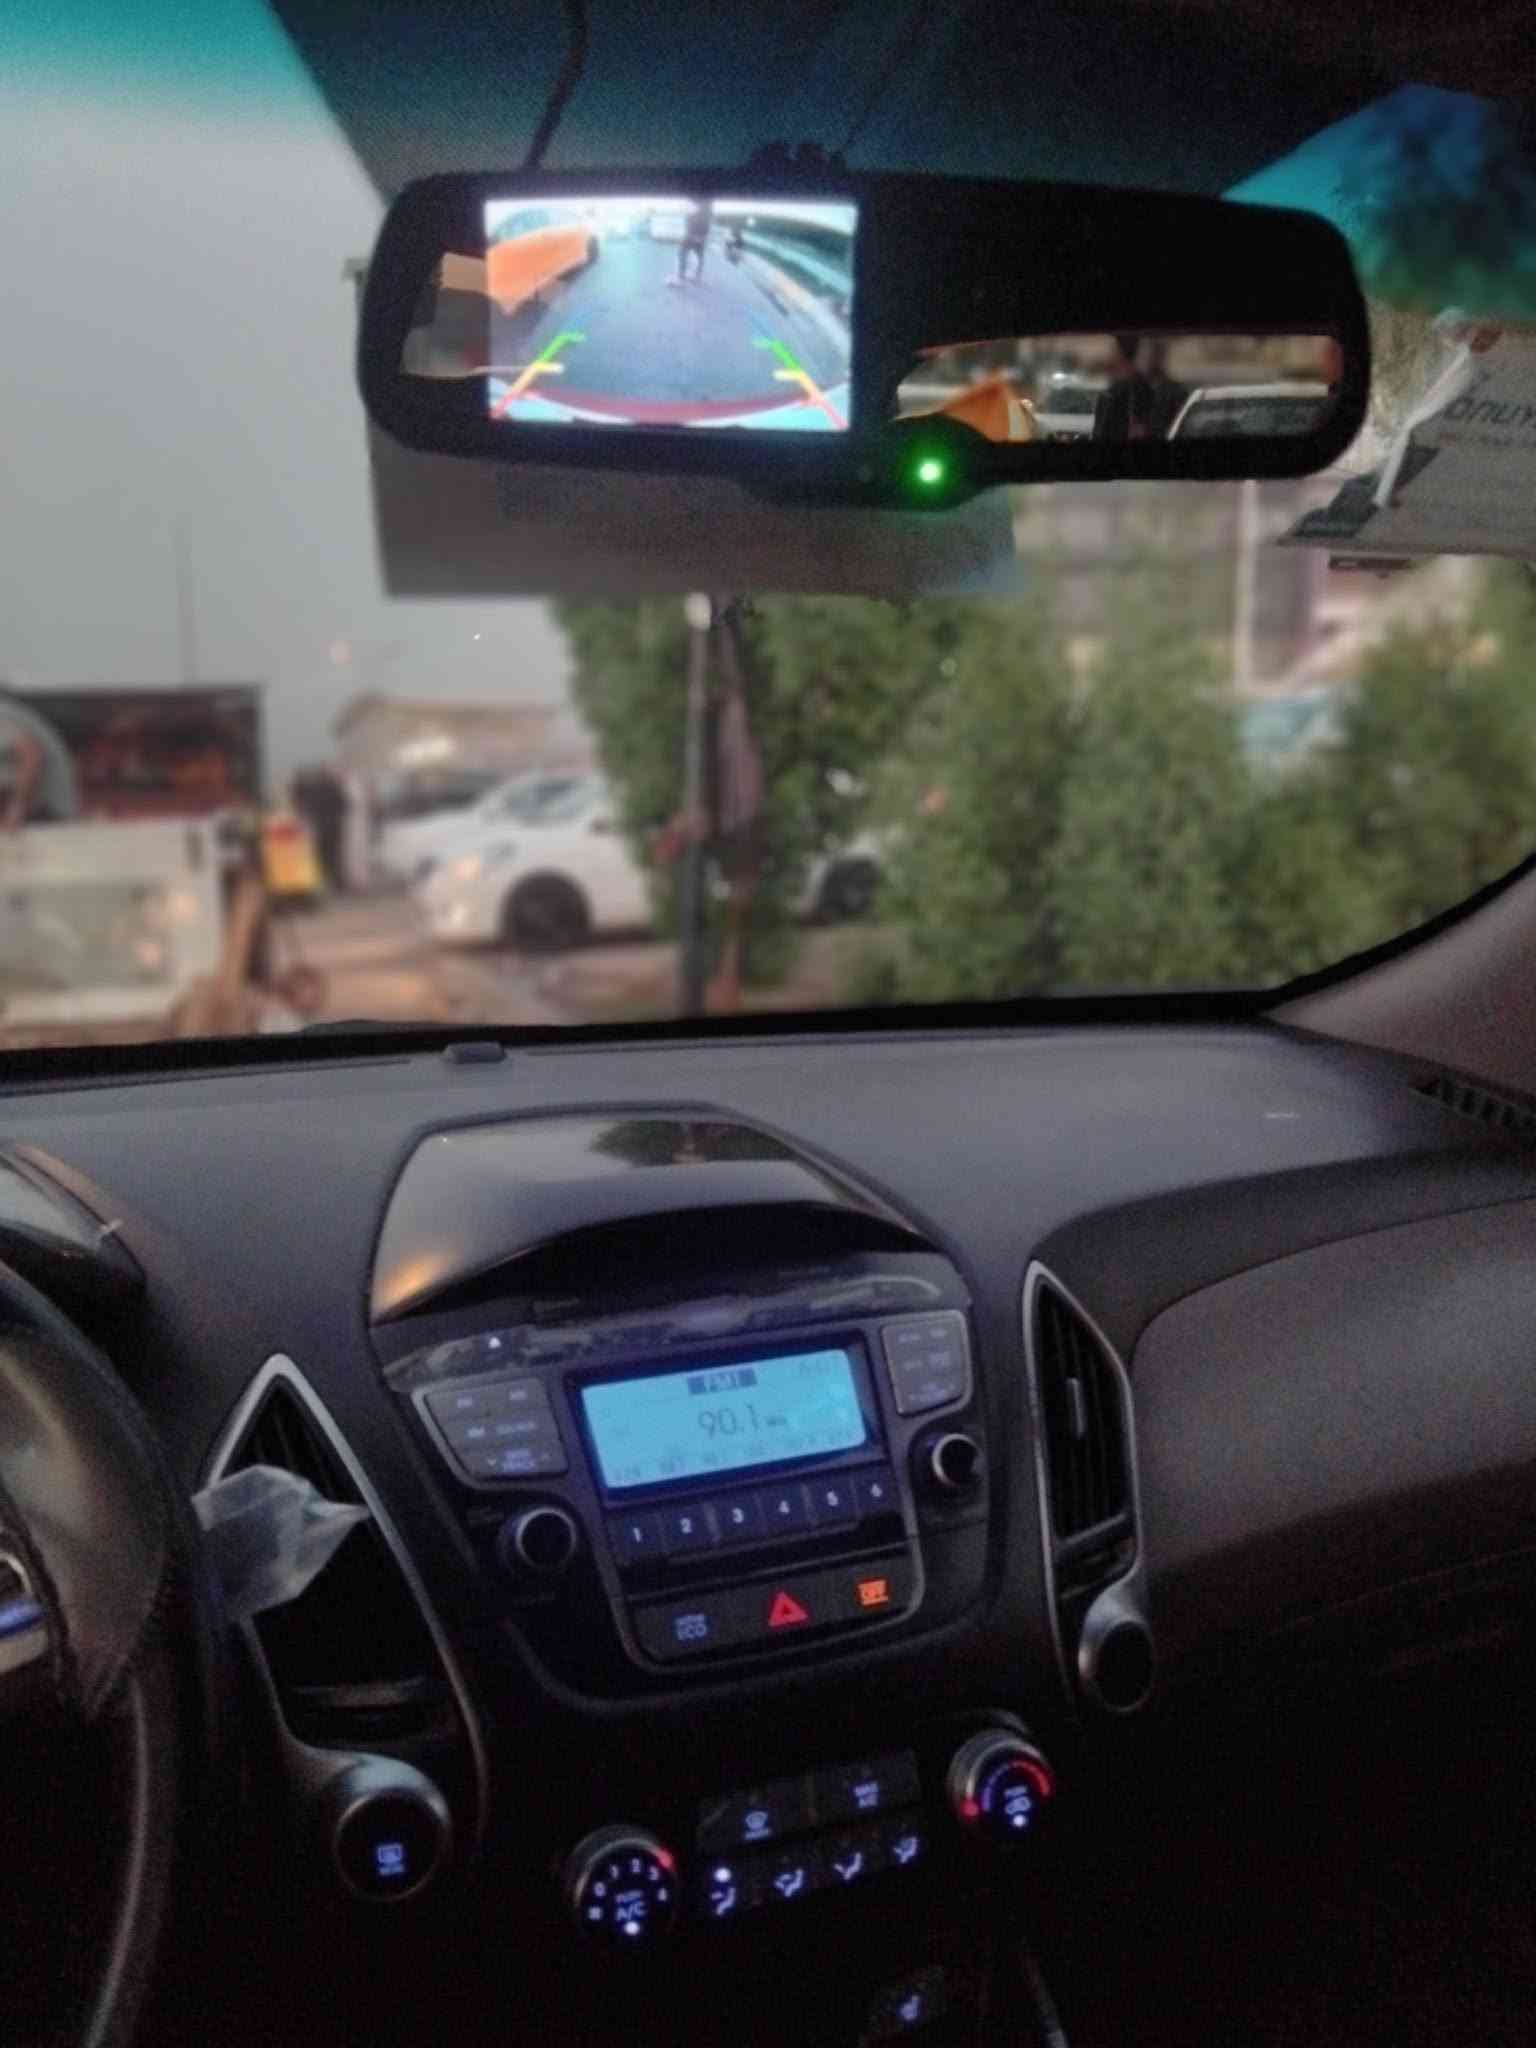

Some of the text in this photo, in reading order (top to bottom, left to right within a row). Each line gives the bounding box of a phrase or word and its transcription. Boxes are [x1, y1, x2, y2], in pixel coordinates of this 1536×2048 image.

[698, 1402, 760, 1439] 90.1
[632, 1527, 642, 1543] 1
[681, 1517, 693, 1534] 2
[732, 1507, 745, 1524] 3
[779, 1499, 791, 1515] 4
[826, 1489, 840, 1507] 5
